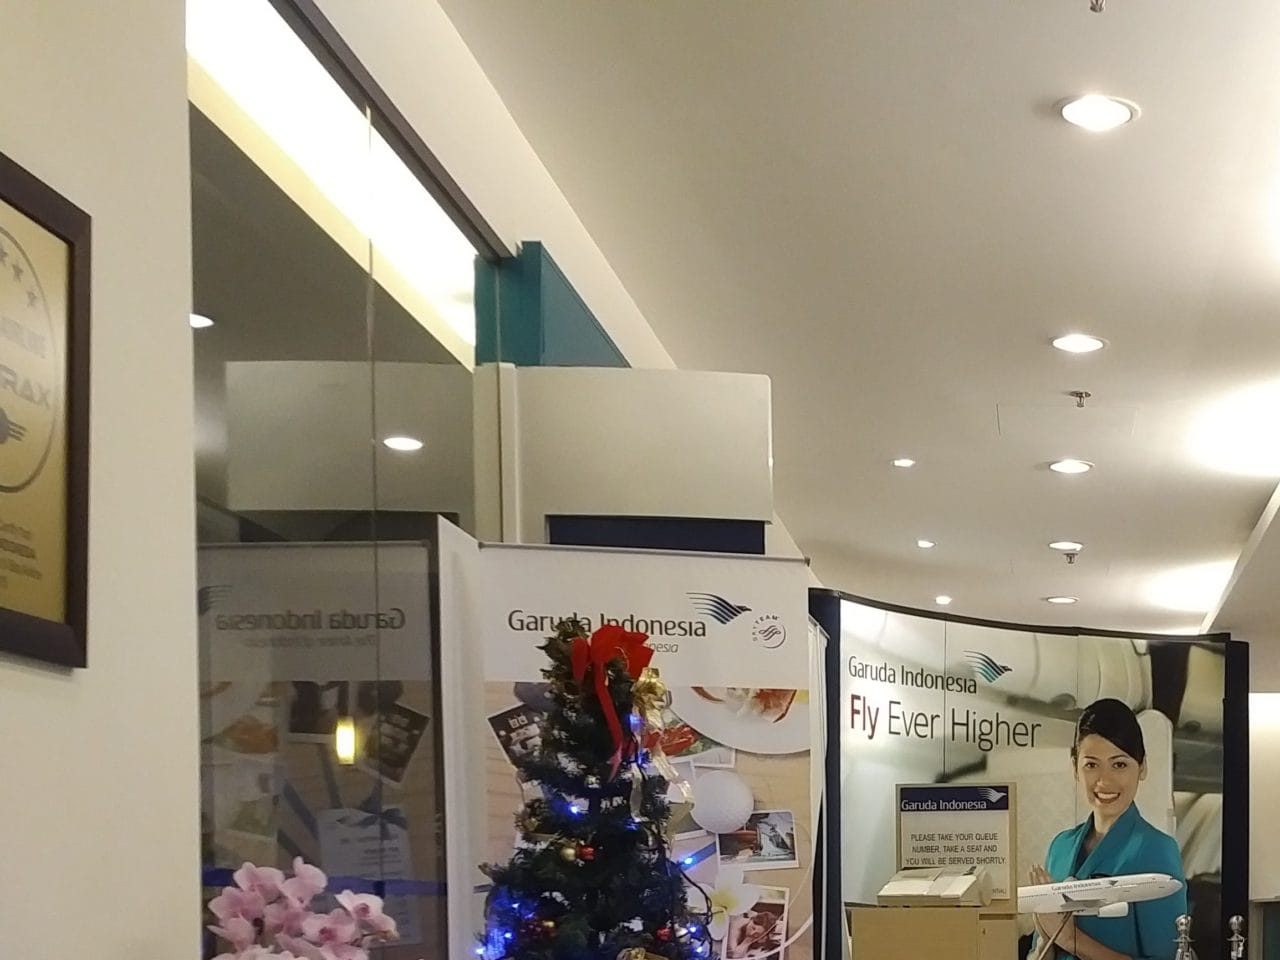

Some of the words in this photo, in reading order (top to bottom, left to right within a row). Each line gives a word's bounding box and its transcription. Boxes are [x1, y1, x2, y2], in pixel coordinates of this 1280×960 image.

[643, 642, 679, 654] nesia
[848, 655, 896, 684] Garuda
[901, 665, 977, 694] Indonesia
[850, 693, 880, 740] Fly
[888, 700, 941, 739] Ever
[951, 708, 1042, 752] Higher
[901, 799, 937, 810] Garuda
[940, 799, 987, 810] Indonesia
[911, 833, 936, 842] PLEASE
[937, 833, 953, 841] TAKE
[955, 833, 974, 841] YOUR
[975, 832, 998, 841] QUEUE
[943, 845, 959, 853] TAKE
[966, 845, 982, 853] SEAT
[983, 845, 998, 853] AND
[905, 857, 920, 865] YOU
[920, 857, 936, 865] WILL
[938, 857, 946, 865] BE
[948, 857, 975, 865] SERVED
